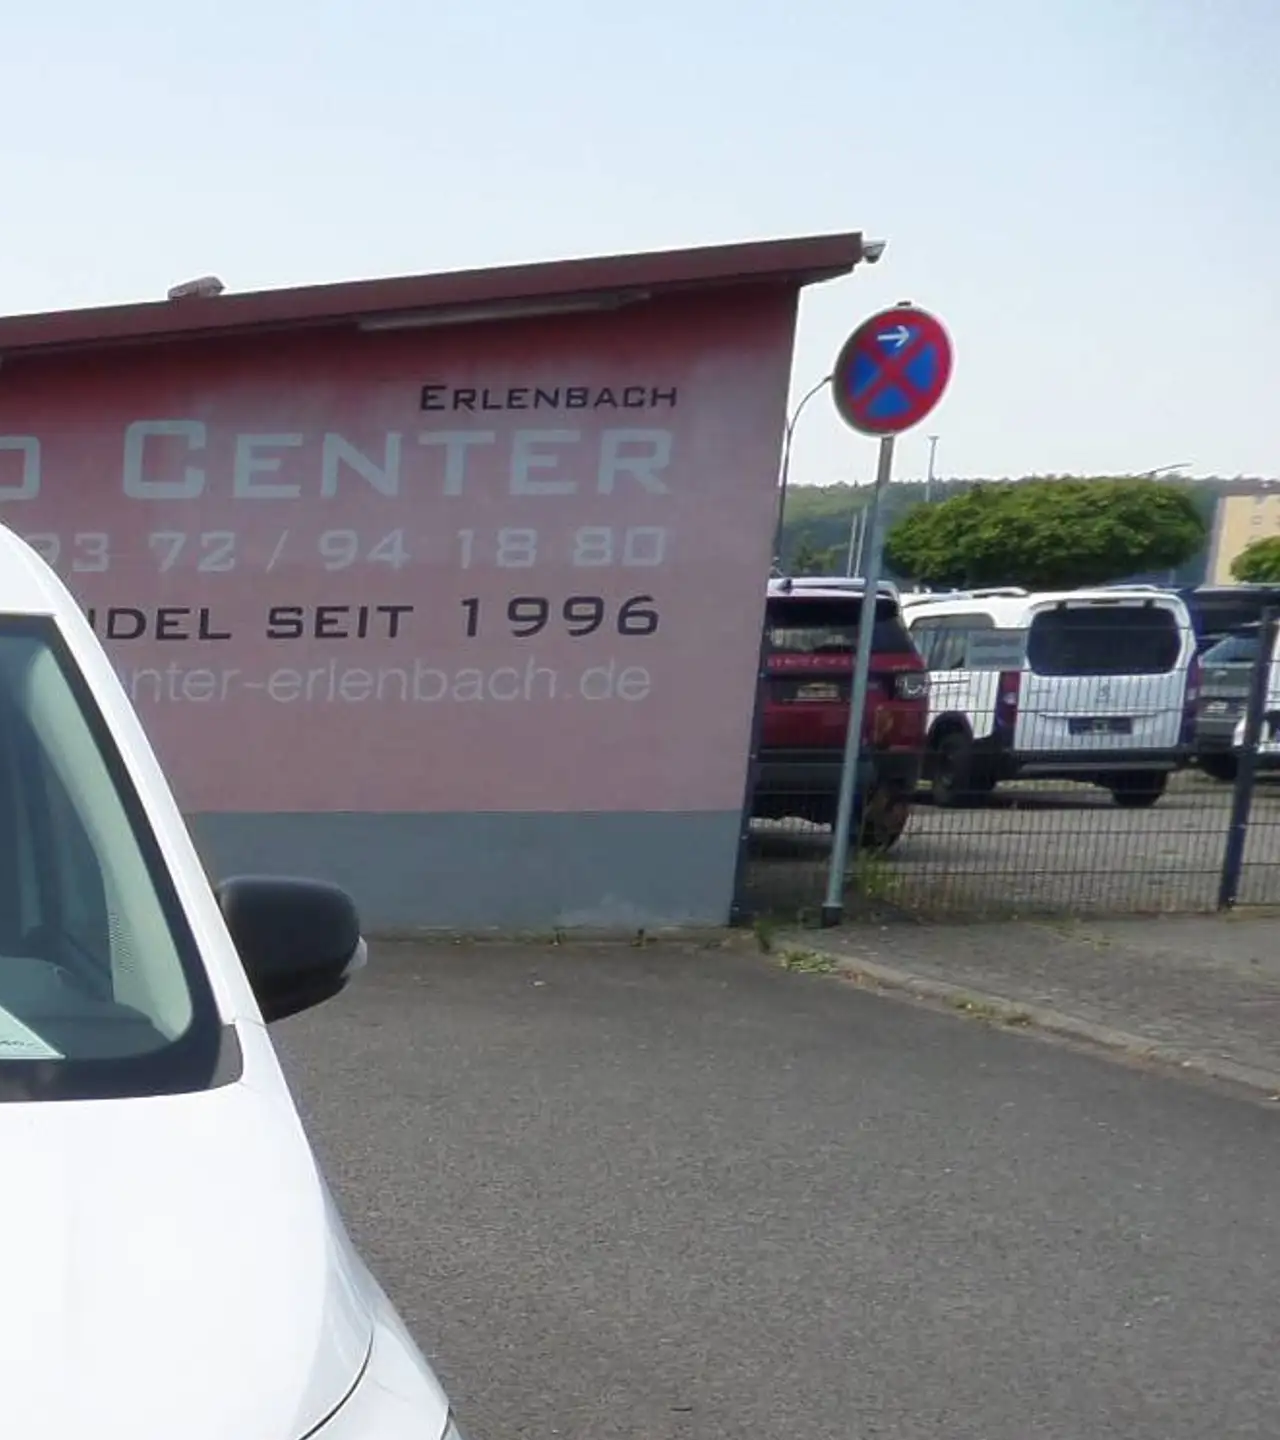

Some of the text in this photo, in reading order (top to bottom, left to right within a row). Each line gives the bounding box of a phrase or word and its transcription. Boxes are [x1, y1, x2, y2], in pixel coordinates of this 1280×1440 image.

[419, 384, 678, 411] ERLENBACH
[121, 418, 675, 500] CENTER
[148, 530, 237, 573] 72
[265, 528, 290, 574] /
[317, 528, 412, 571] 94
[456, 528, 538, 570] 18
[572, 525, 668, 567] 80
[266, 605, 415, 639] SEIT
[460, 594, 660, 638] 1996
